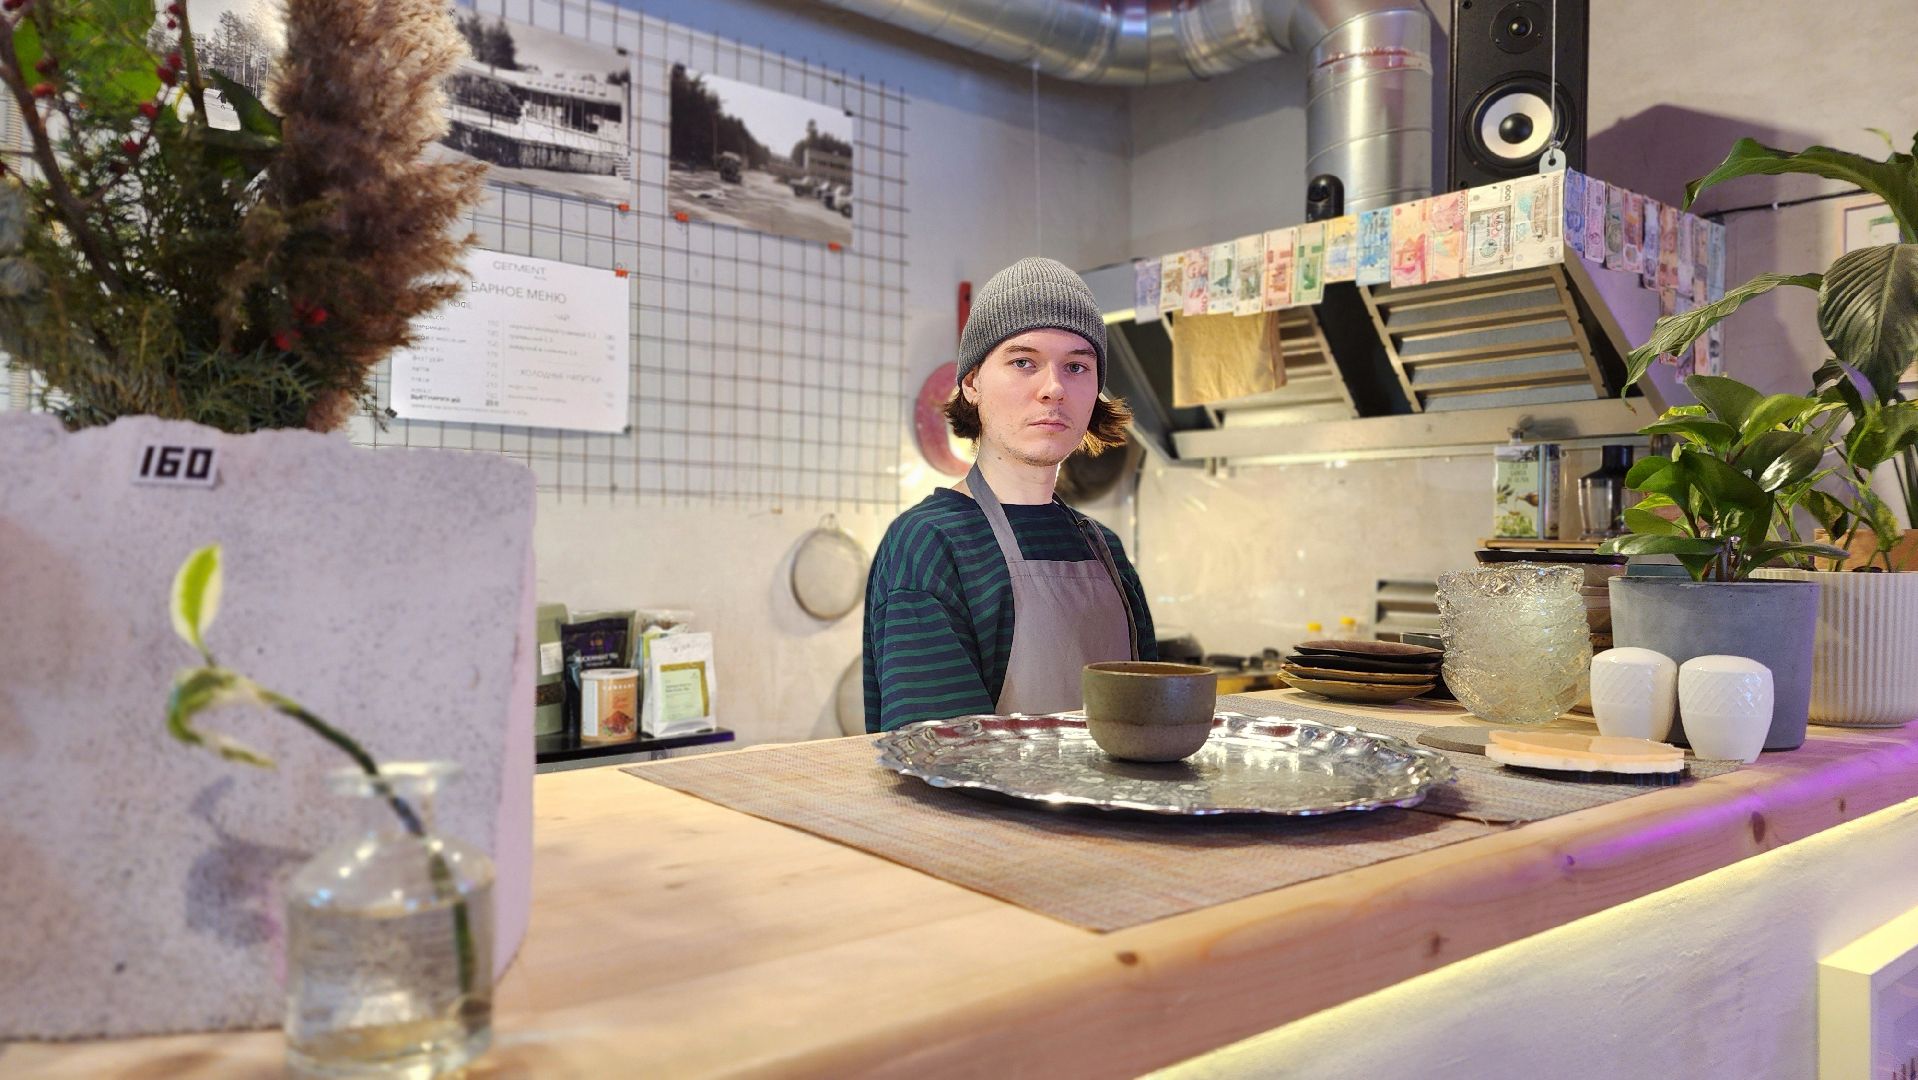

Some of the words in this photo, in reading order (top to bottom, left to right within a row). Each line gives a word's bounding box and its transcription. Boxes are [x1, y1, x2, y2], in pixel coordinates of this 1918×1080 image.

[471, 281, 523, 298] БАРНОЕ
[526, 289, 567, 304] МЕНЮ
[140, 445, 213, 480] 160
